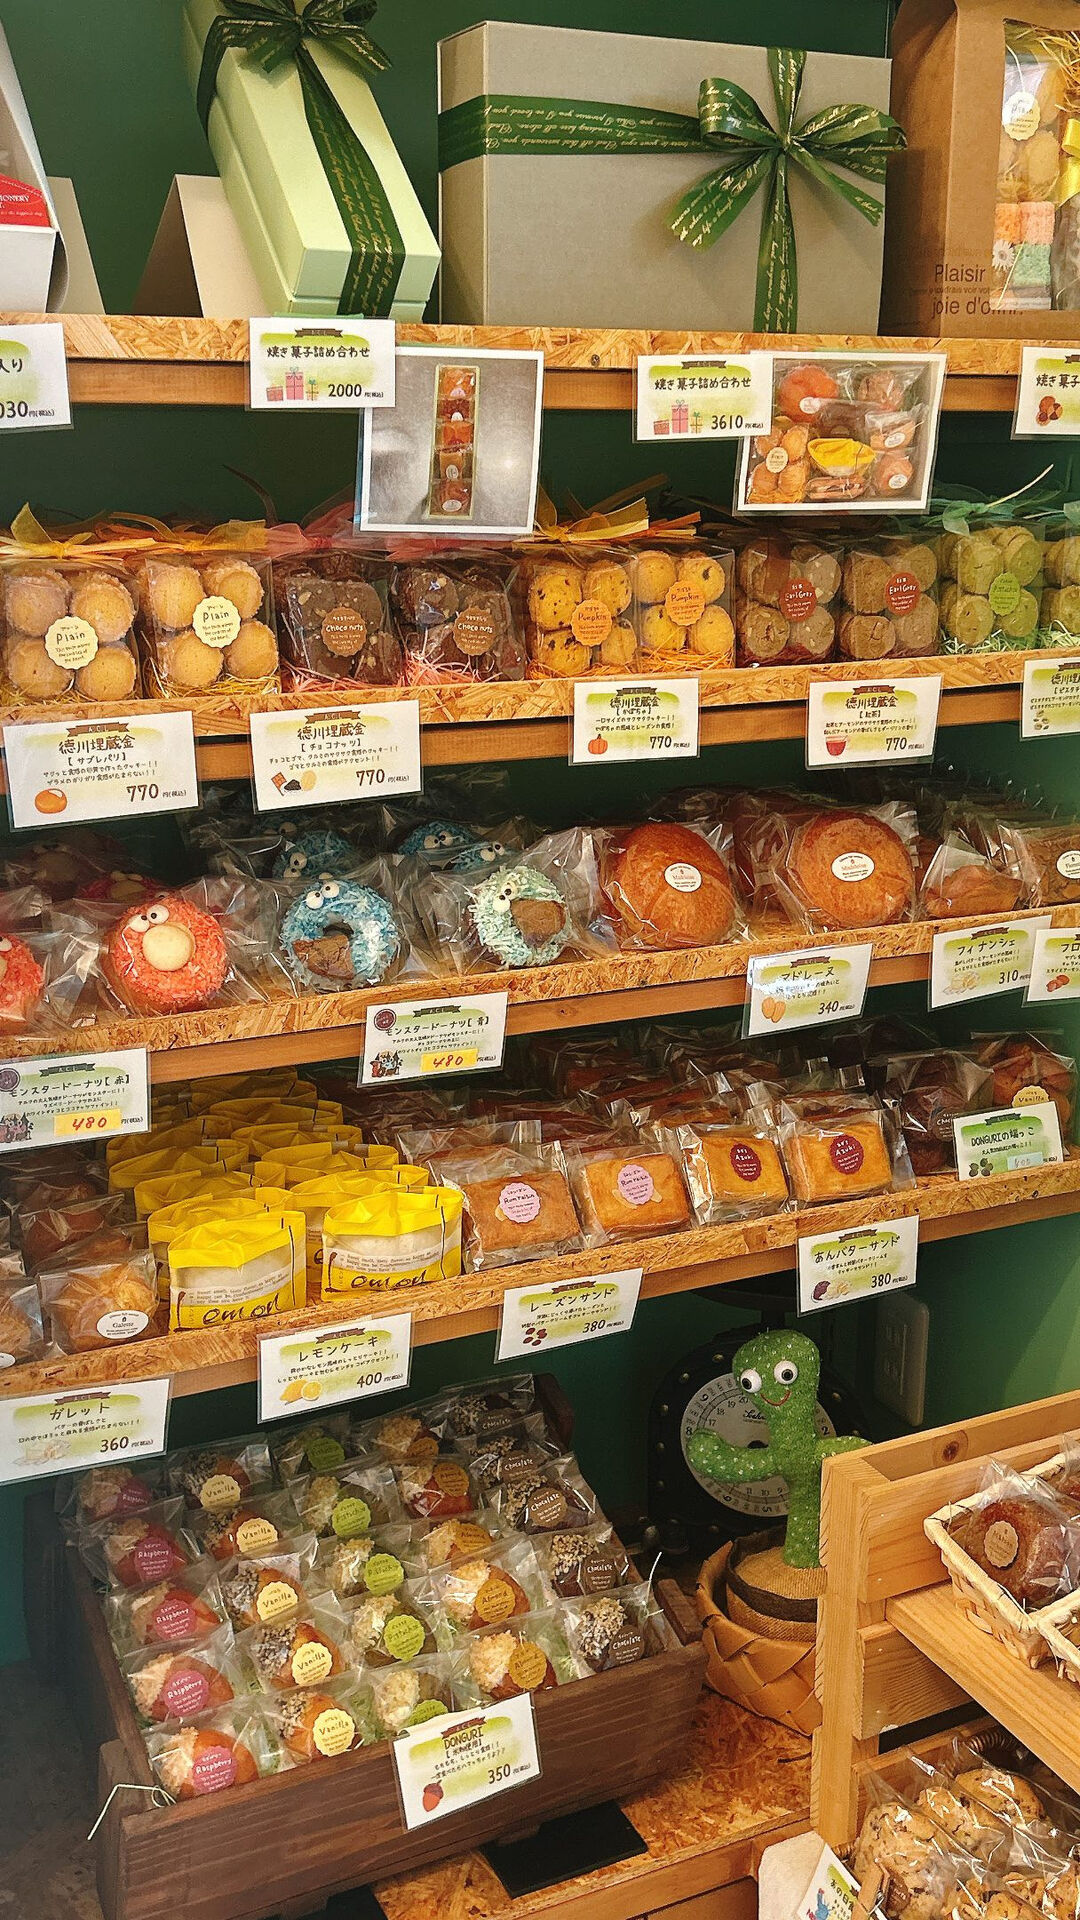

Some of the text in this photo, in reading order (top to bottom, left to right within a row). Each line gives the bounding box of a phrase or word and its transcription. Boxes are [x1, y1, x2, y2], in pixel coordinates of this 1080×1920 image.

[934, 264, 986, 282] Plaisir
[932, 297, 960, 320] joie
[267, 345, 370, 358] 焼き菓子詰め合わせ
[654, 376, 752, 390] 焼き菓子詰め合わせ
[1036, 373, 1080, 388] 焼き菓子
[328, 384, 362, 398] 2000
[711, 415, 744, 430] 3610
[671, 593, 699, 602] Pumpkin
[203, 612, 230, 623] Plain
[578, 612, 606, 622] Pumpkin
[56, 632, 86, 645] Plain
[610, 696, 660, 708] 徳川埋蔵金
[846, 696, 898, 710] 徳川埋蔵金
[616, 705, 652, 716] 【かぼちゃ】
[860, 710, 880, 719] 【紅茶】
[297, 722, 366, 740] 徳川埋蔵金
[58, 734, 136, 754] 徳川埋蔵金
[301, 738, 362, 752] 【チョコナッツ】
[650, 736, 672, 750] 770
[886, 738, 907, 752] 770
[356, 768, 385, 786] 770
[126, 784, 159, 802] 770
[958, 938, 1016, 956] フィナンシェ
[781, 967, 836, 981] マドレーヌ
[998, 969, 1019, 984] 310
[818, 1000, 839, 1014] 340
[386, 1016, 489, 1037] モンスタードーナツ【青】
[433, 1055, 464, 1068] 480
[10, 1074, 130, 1098] モンスタードーナツ【赤】
[72, 1116, 107, 1130] 480
[971, 1127, 1034, 1146] DONGURIの端っこ
[836, 1144, 856, 1156] Azuki
[814, 1236, 900, 1264] あんバターサンド
[871, 1272, 892, 1288] 380
[531, 1288, 615, 1312] レーズンサンド
[583, 1320, 606, 1334] 380
[300, 1336, 379, 1362] レモンケーキ
[357, 1372, 382, 1388] 400
[50, 1402, 110, 1420] ガレット
[100, 1436, 130, 1452] 360
[504, 1459, 533, 1470] Chocolate
[206, 1485, 235, 1498] Vanilla
[531, 1494, 559, 1511] Chocolate
[242, 1529, 272, 1540] Vanilla
[587, 1564, 612, 1573] Chocolate
[262, 1593, 292, 1608] Vanilla
[156, 1608, 189, 1624] Raspberry
[612, 1636, 641, 1650] Chocolate
[297, 1652, 326, 1670] Vanilla
[168, 1680, 202, 1699] Raspberry
[319, 1721, 348, 1735] Vanilla
[444, 1726, 484, 1750] DONGURI
[196, 1758, 231, 1774] Raspberry
[488, 1763, 511, 1784] 350
